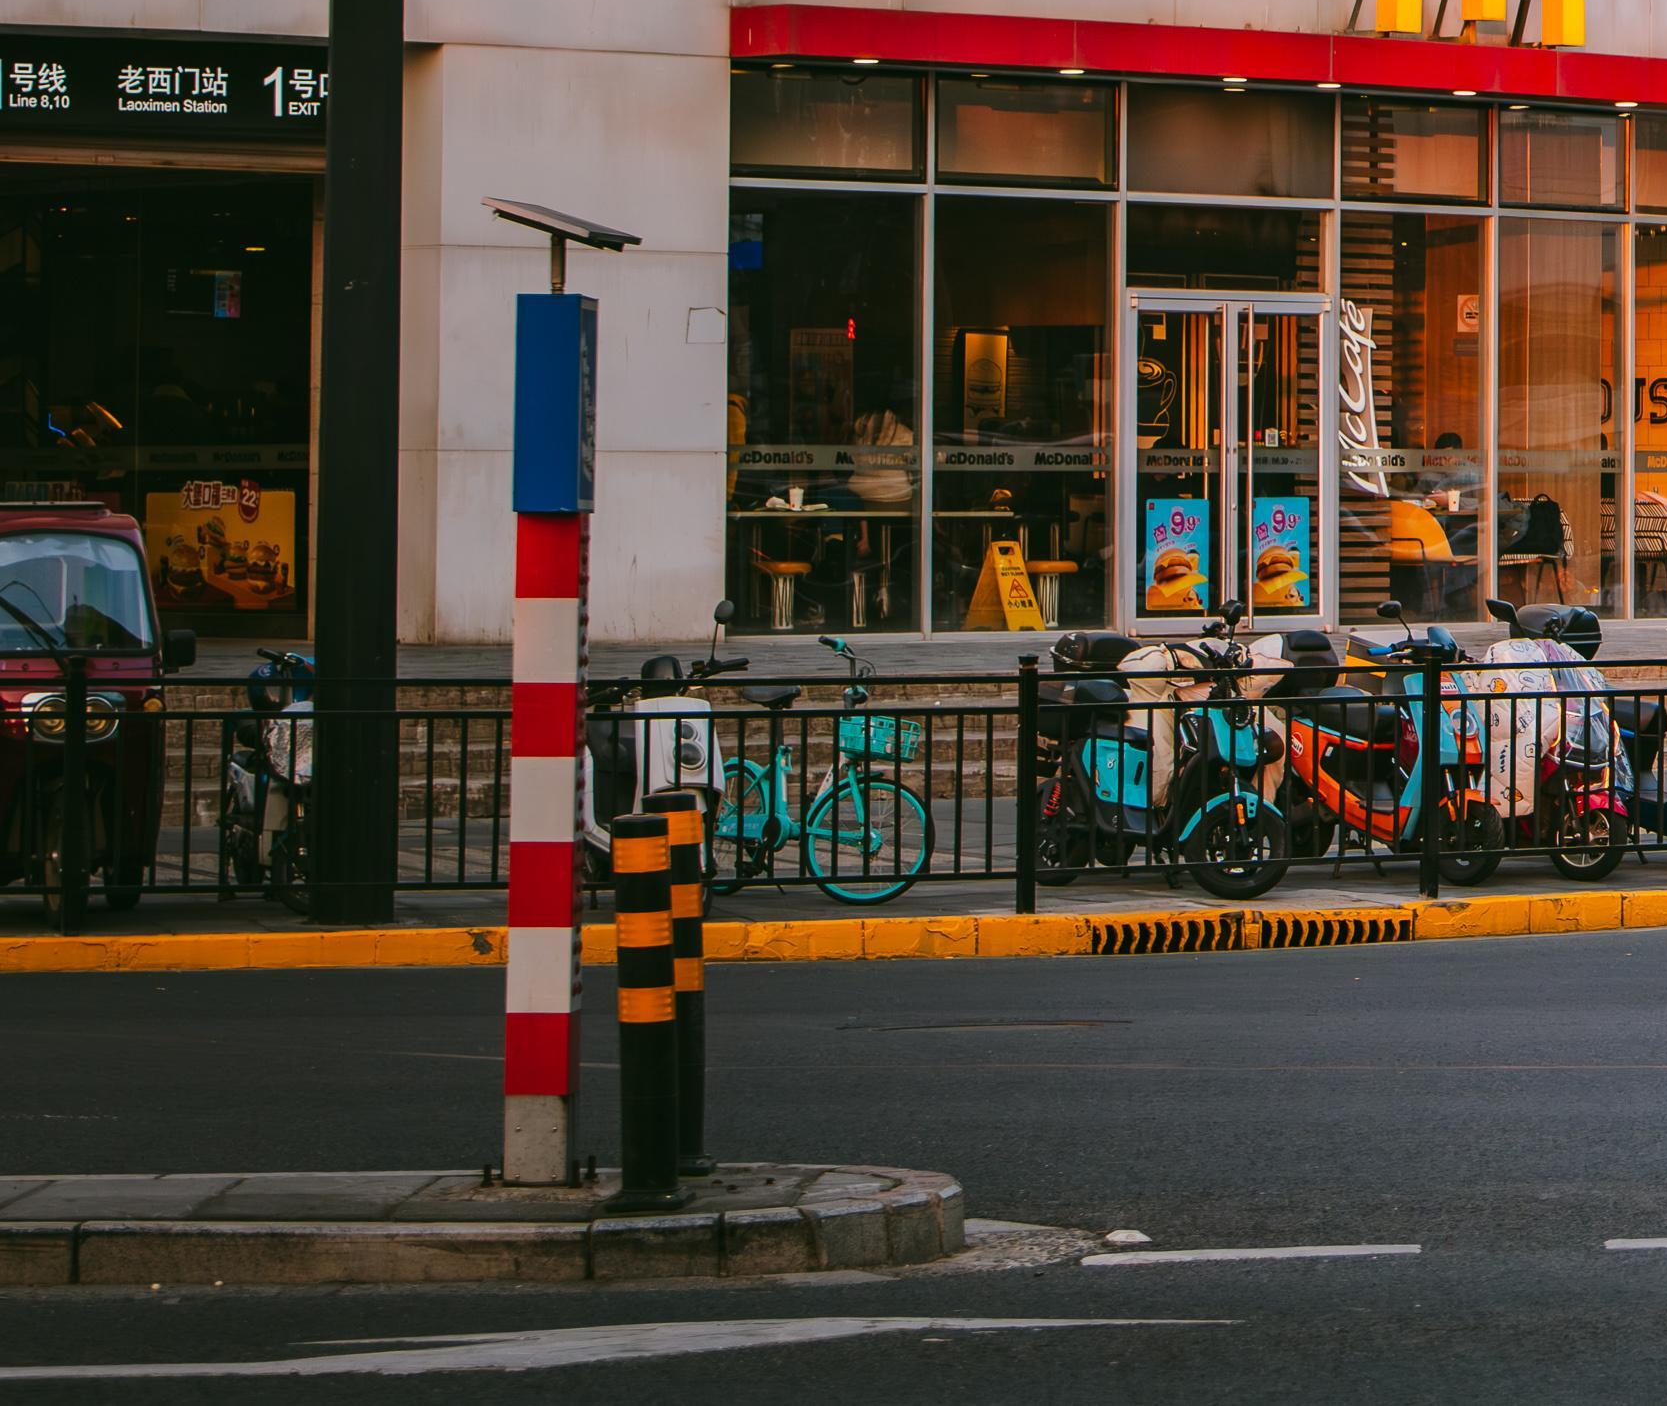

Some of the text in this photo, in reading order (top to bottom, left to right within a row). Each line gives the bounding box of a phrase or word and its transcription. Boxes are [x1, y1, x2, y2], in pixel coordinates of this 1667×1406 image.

[117, 64, 229, 97] 老西门站
[9, 94, 71, 111] Line 8,10
[118, 97, 228, 114] Laoximen Station
[288, 101, 321, 116] EXIT
